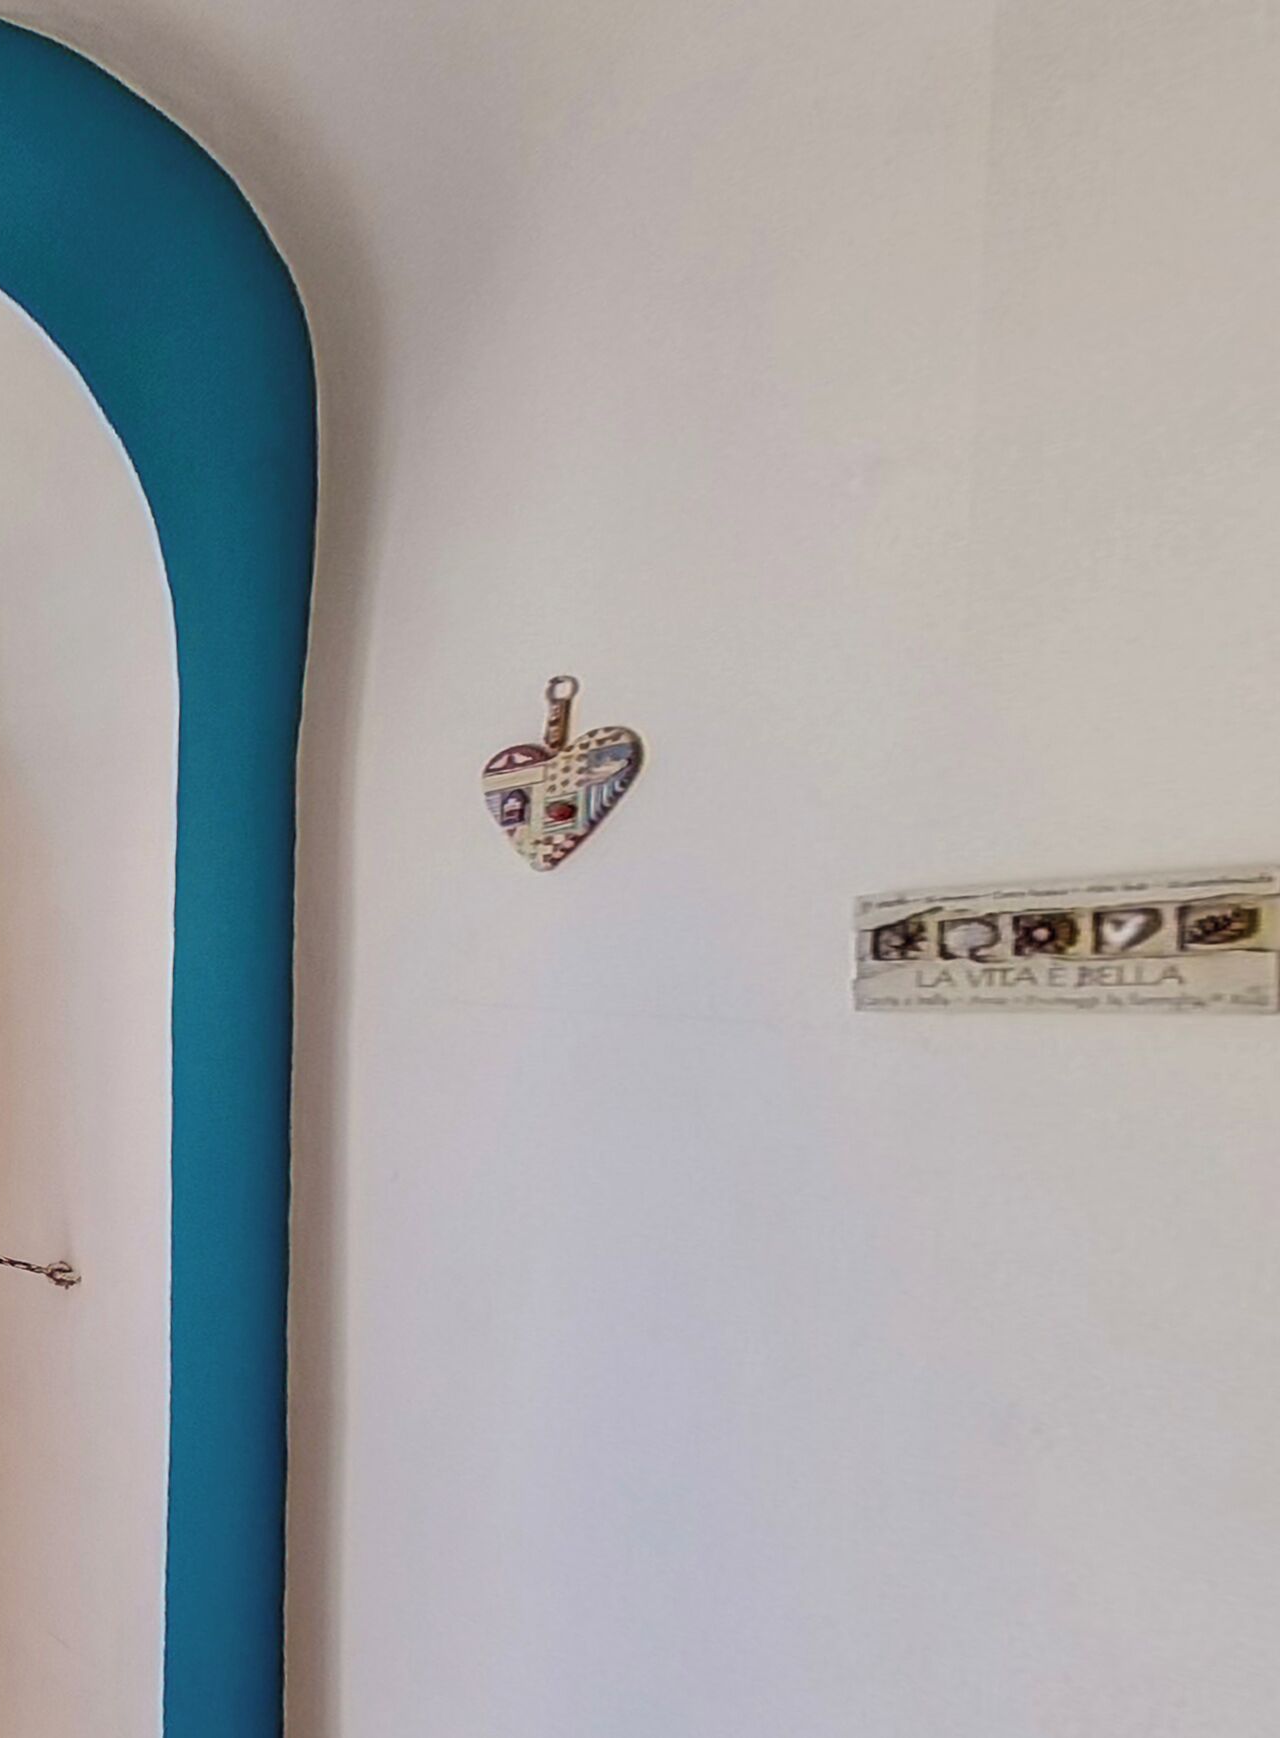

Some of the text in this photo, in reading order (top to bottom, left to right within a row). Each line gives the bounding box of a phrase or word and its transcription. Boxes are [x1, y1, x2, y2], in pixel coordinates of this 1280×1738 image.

[916, 968, 954, 988] LA
[966, 966, 1038, 988] VITA
[1075, 965, 1184, 988] BELLA
